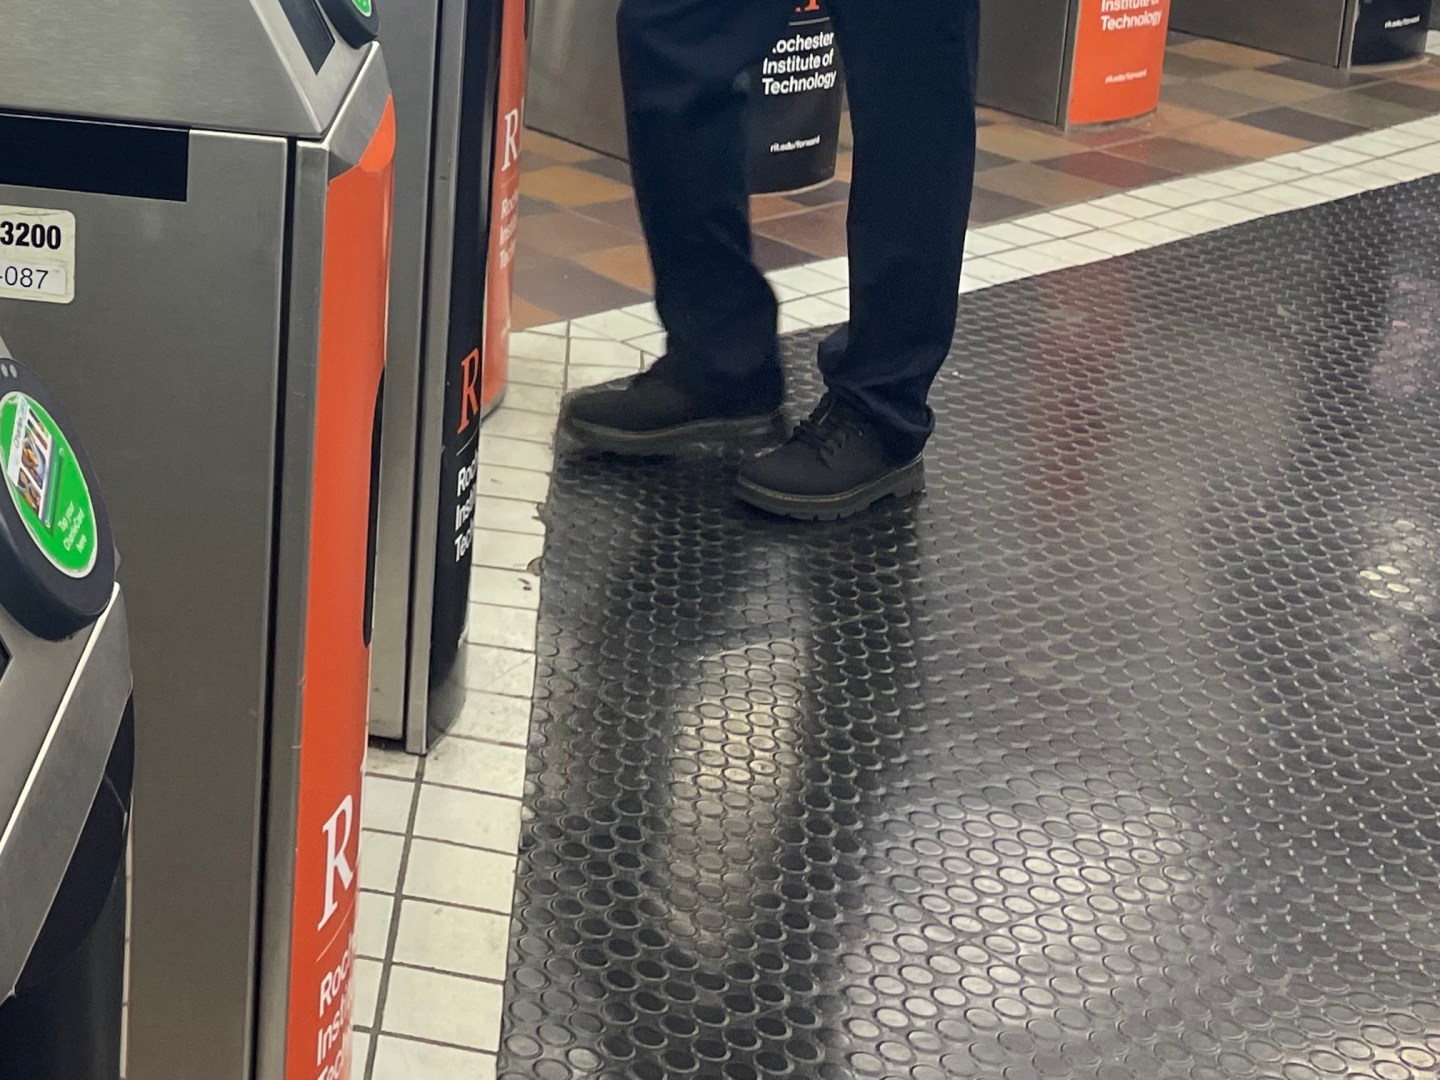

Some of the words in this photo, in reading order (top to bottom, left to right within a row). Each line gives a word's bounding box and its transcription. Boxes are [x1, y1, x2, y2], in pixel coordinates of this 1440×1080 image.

[1100, 10, 1163, 32] Technology
[772, 31, 835, 54] ochester
[762, 52, 820, 75] Institute
[821, 48, 835, 67] of
[762, 70, 837, 96] Technology
